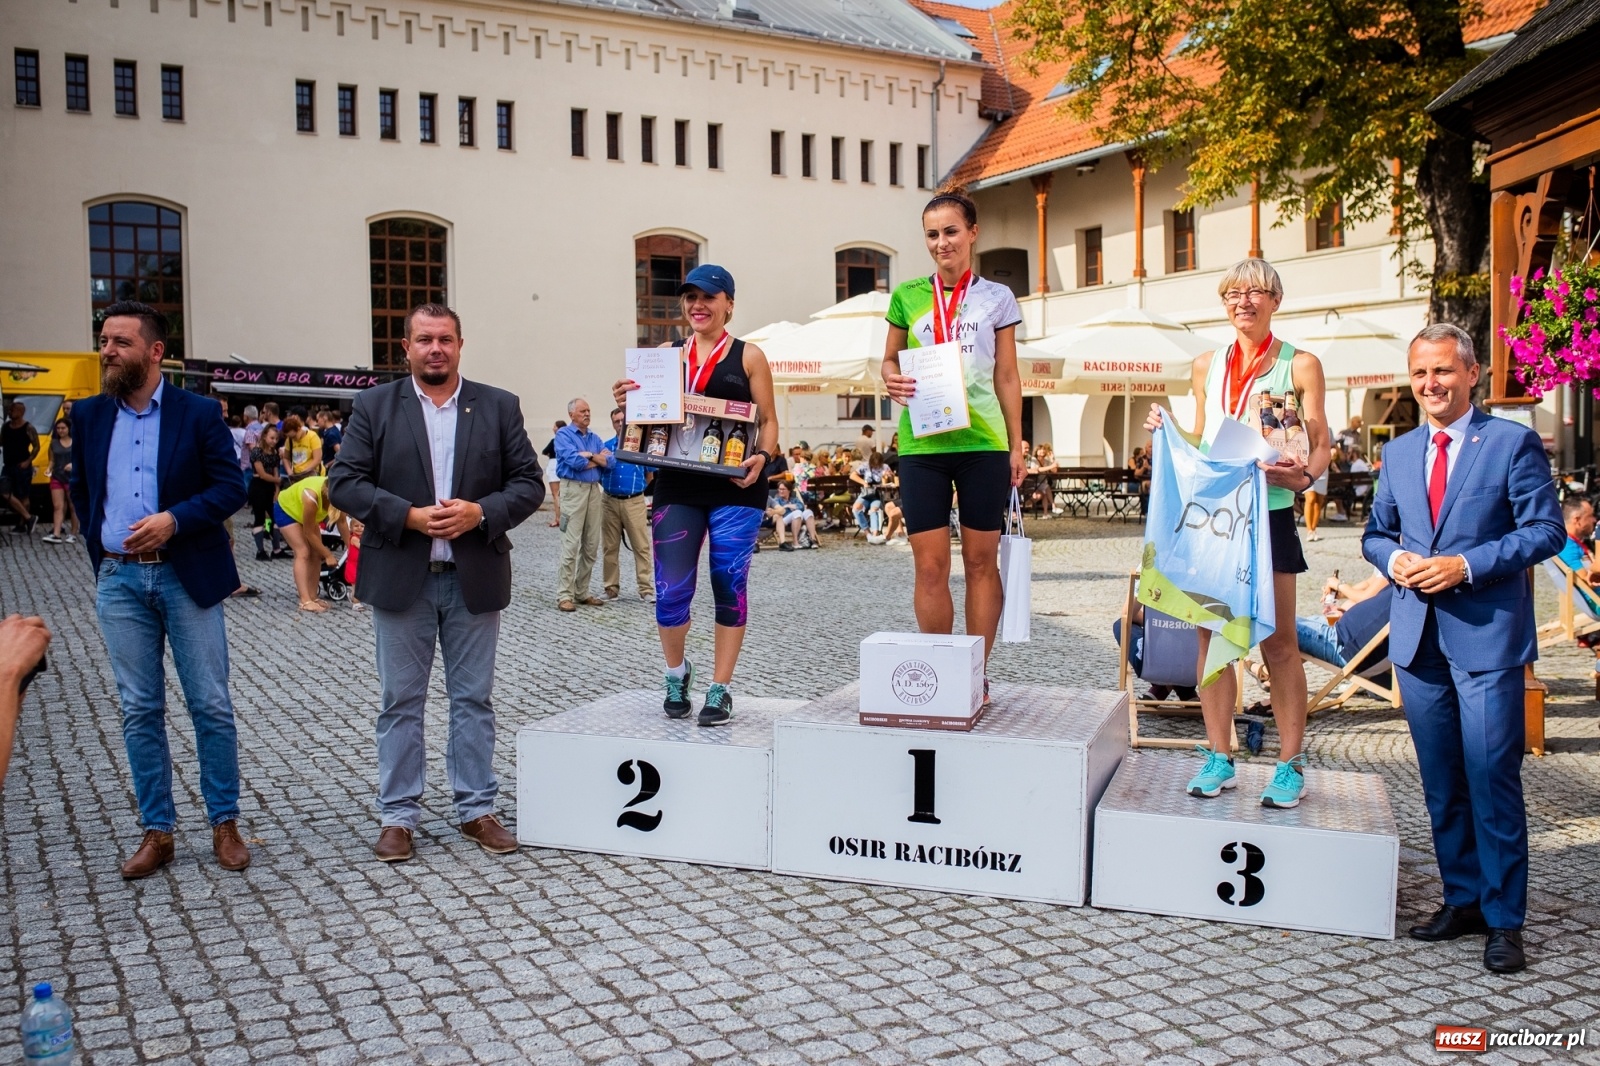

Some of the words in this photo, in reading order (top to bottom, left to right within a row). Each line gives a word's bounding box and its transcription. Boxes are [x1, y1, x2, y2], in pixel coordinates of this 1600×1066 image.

[922, 322, 978, 333] AYWNI
[961, 344, 974, 353] RT
[769, 360, 822, 374] RACIBORSKIE
[1083, 361, 1163, 373] RACIBORSKIE
[213, 367, 263, 383] SLOW
[276, 371, 310, 384] BBQ
[324, 374, 379, 387] TRUCK
[921, 372, 943, 380] DYPLOM
[1346, 374, 1395, 387] RACIBORSKIE
[684, 402, 716, 414] BORSKIE
[916, 679, 934, 691] 1567
[907, 749, 941, 824] 1
[616, 759, 663, 832] 2
[829, 836, 886, 859] OSIR
[894, 846, 1022, 873] RACIBÓRZ
[1217, 842, 1265, 907] 3
